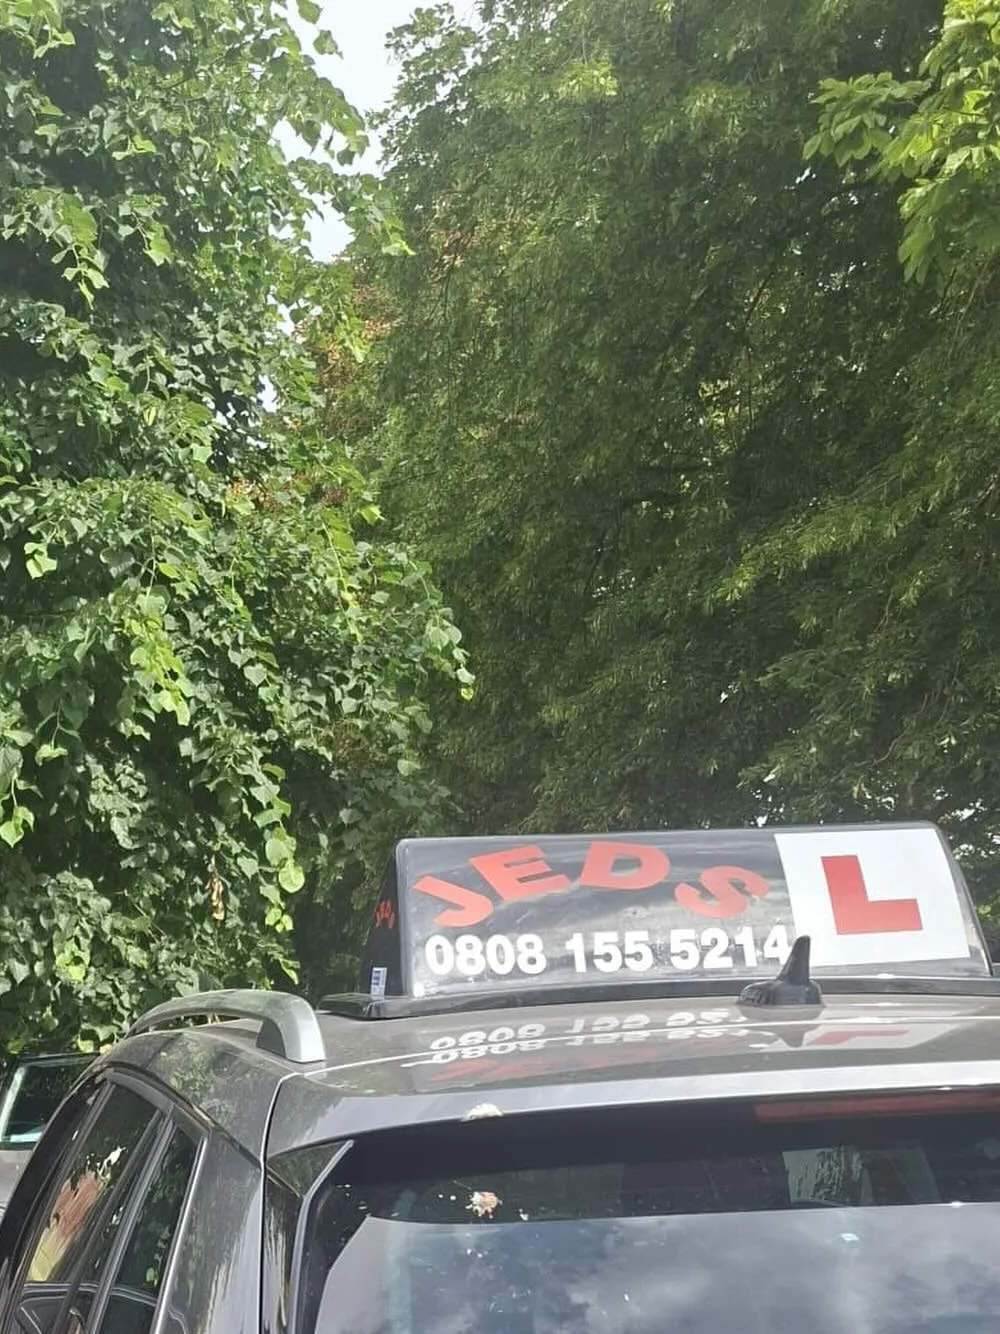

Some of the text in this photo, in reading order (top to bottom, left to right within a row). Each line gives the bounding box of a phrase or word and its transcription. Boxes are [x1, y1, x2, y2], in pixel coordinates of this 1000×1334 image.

[412, 841, 770, 927] JEDS
[820, 854, 923, 936] L
[425, 925, 793, 975] 0808 155 5214
